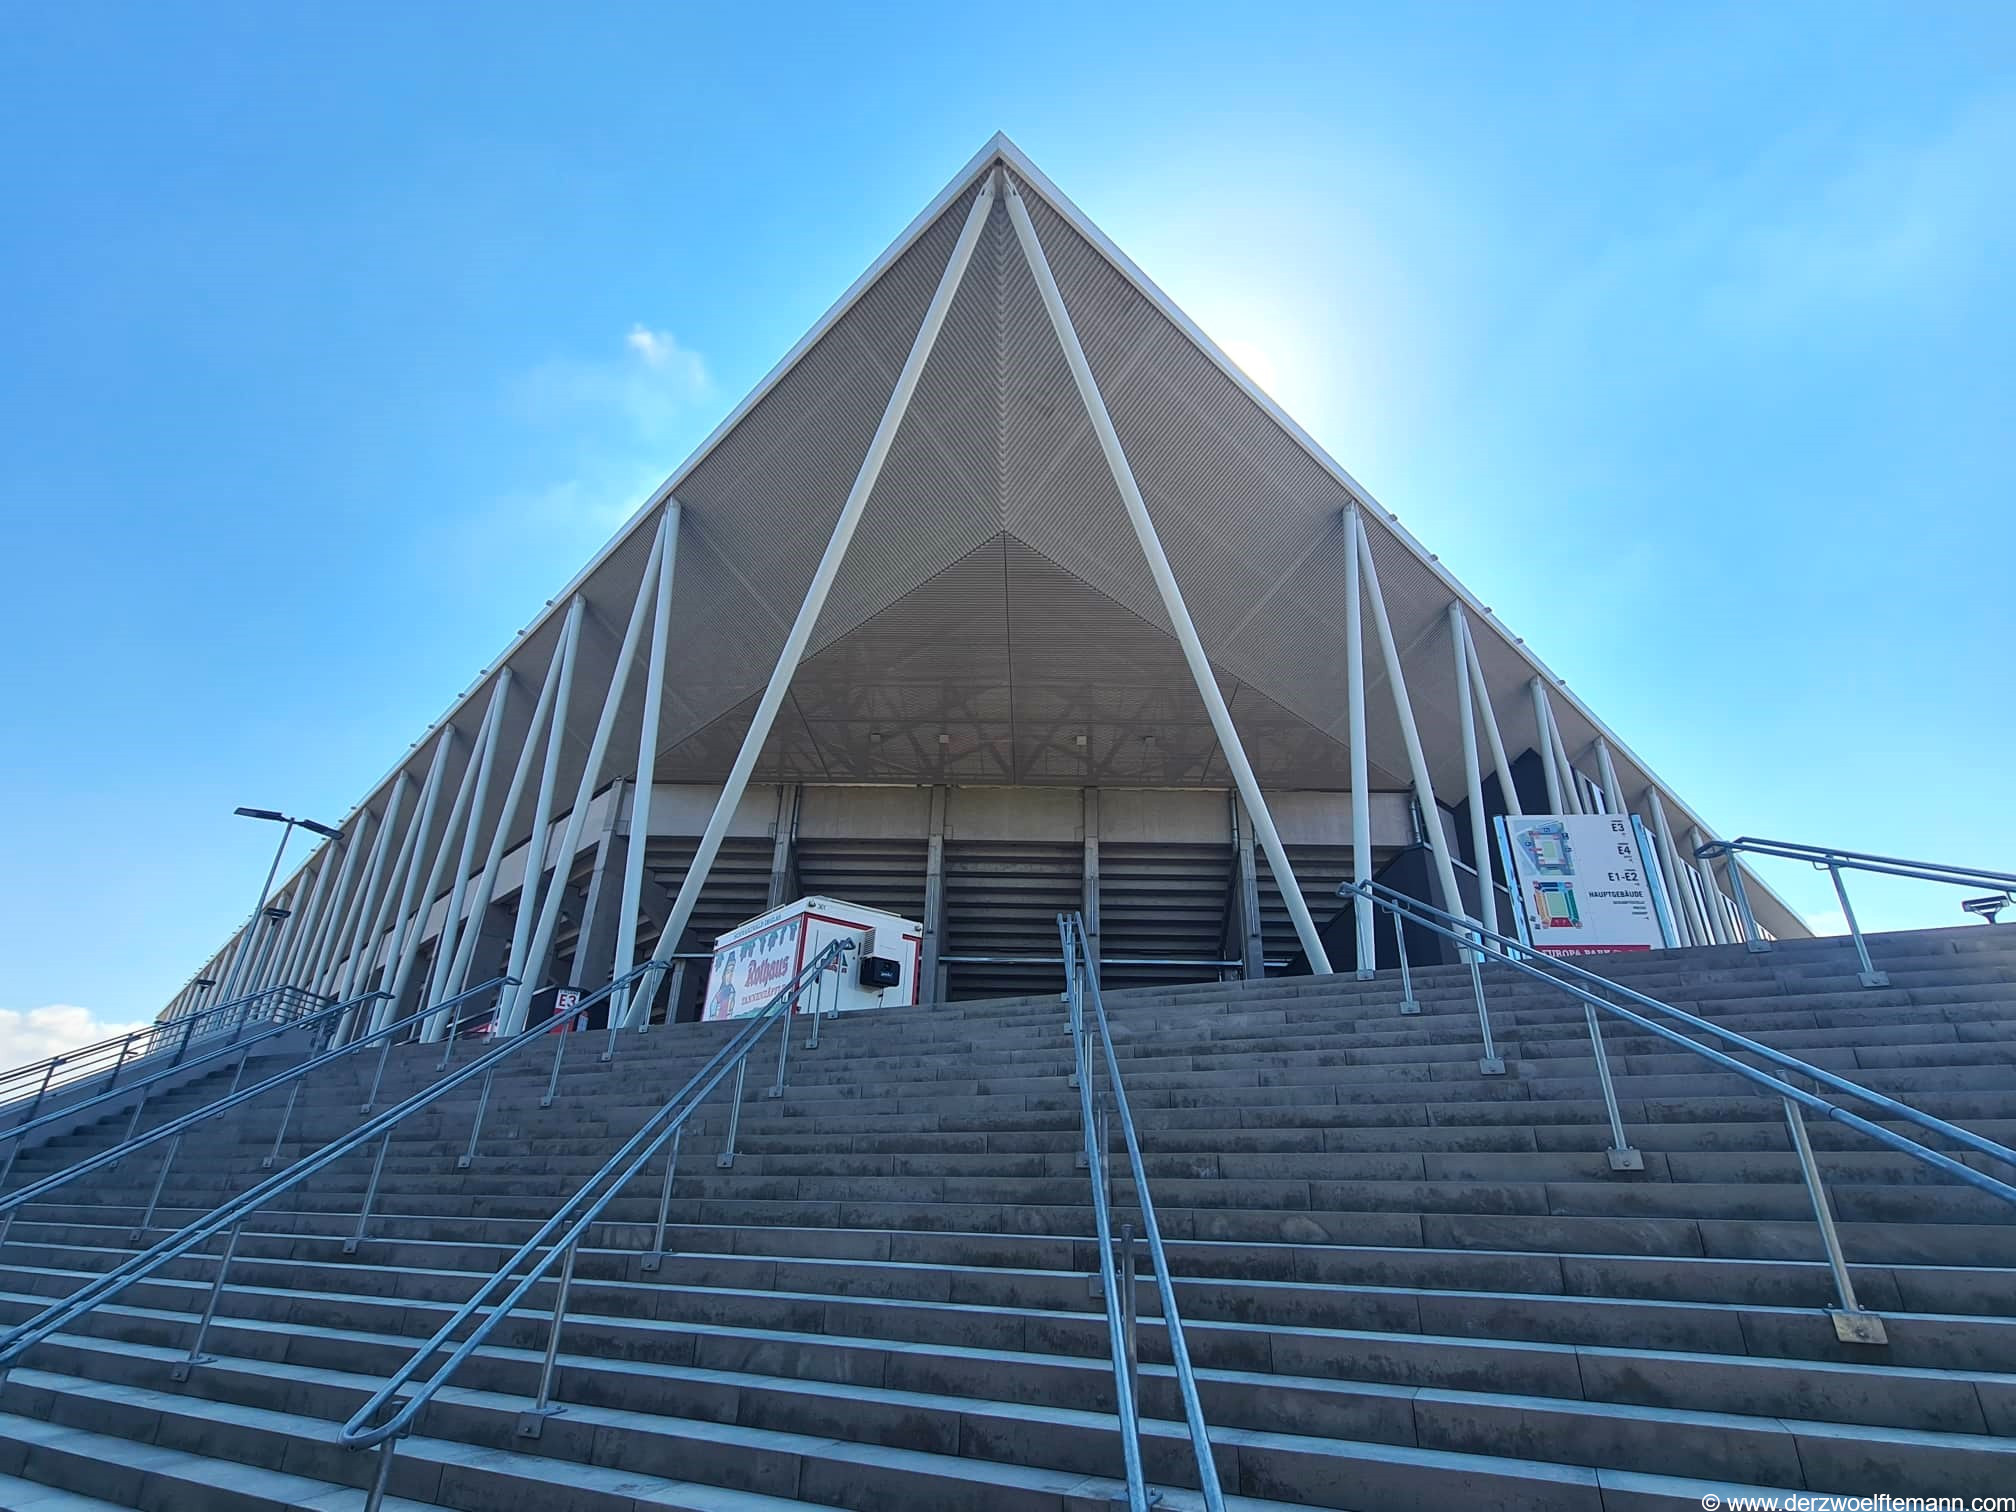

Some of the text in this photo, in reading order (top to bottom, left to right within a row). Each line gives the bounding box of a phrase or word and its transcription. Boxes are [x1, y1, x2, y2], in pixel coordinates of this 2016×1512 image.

[1611, 823, 1625, 831] E3
[1617, 846, 1631, 854] E4
[1608, 872, 1638, 881] E1-E2
[1589, 890, 1644, 898] HAUPTGEBÄUDE
[559, 994, 577, 1007] E3
